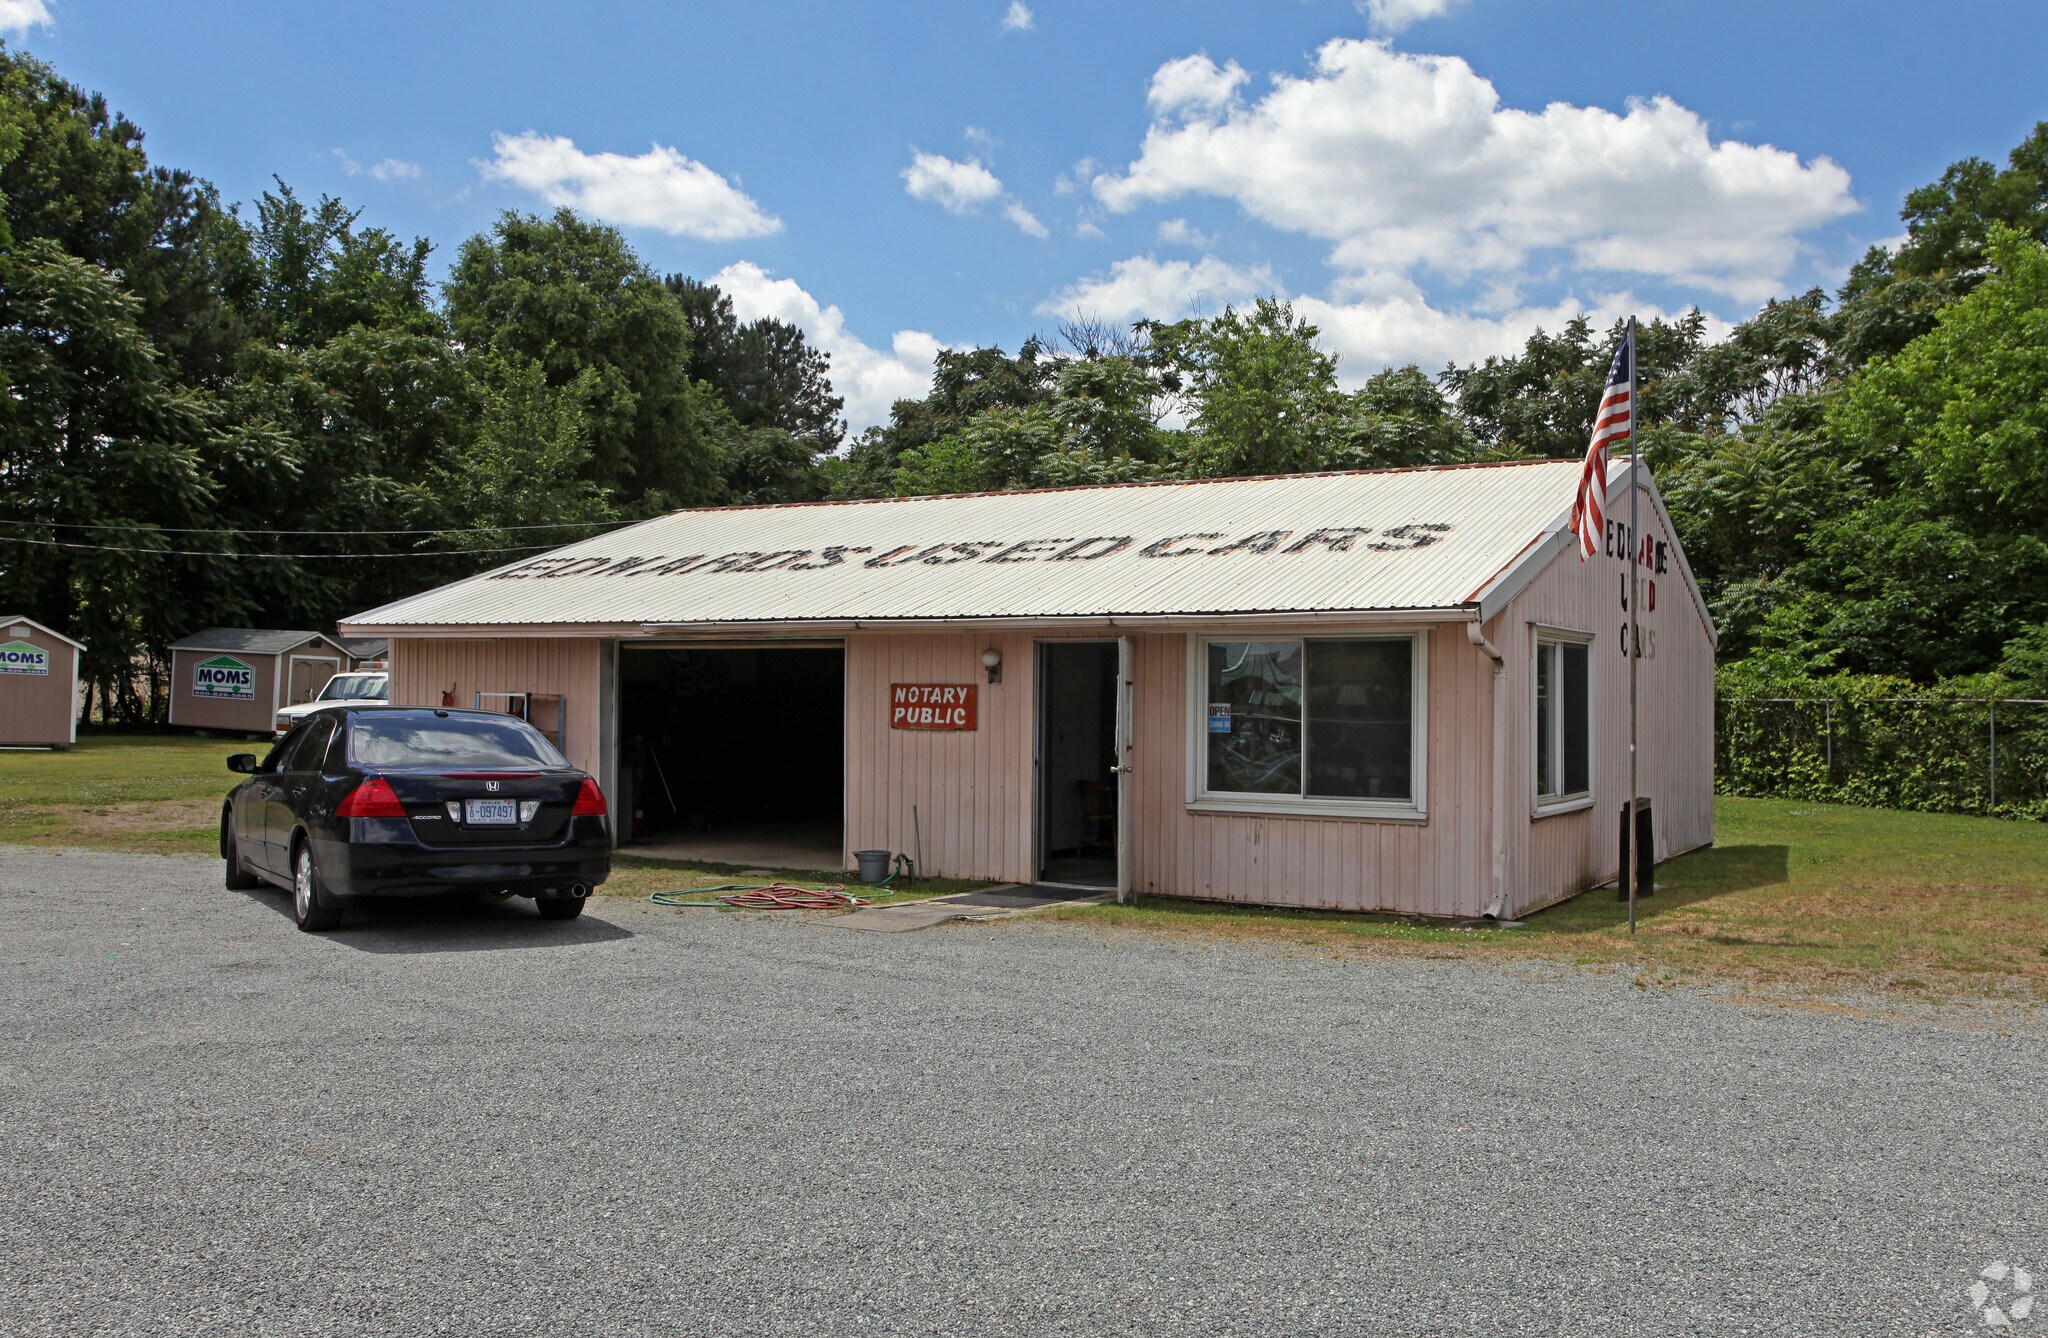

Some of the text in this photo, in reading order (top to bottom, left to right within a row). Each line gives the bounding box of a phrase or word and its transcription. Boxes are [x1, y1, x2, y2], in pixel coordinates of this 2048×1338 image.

[863, 535, 1134, 570] USED
[1138, 522, 1455, 559] CARS
[198, 668, 250, 685] MOMS
[895, 686, 968, 704] NOTARY
[894, 707, 966, 725] PUBLIC
[1209, 706, 1231, 716] OPEN
